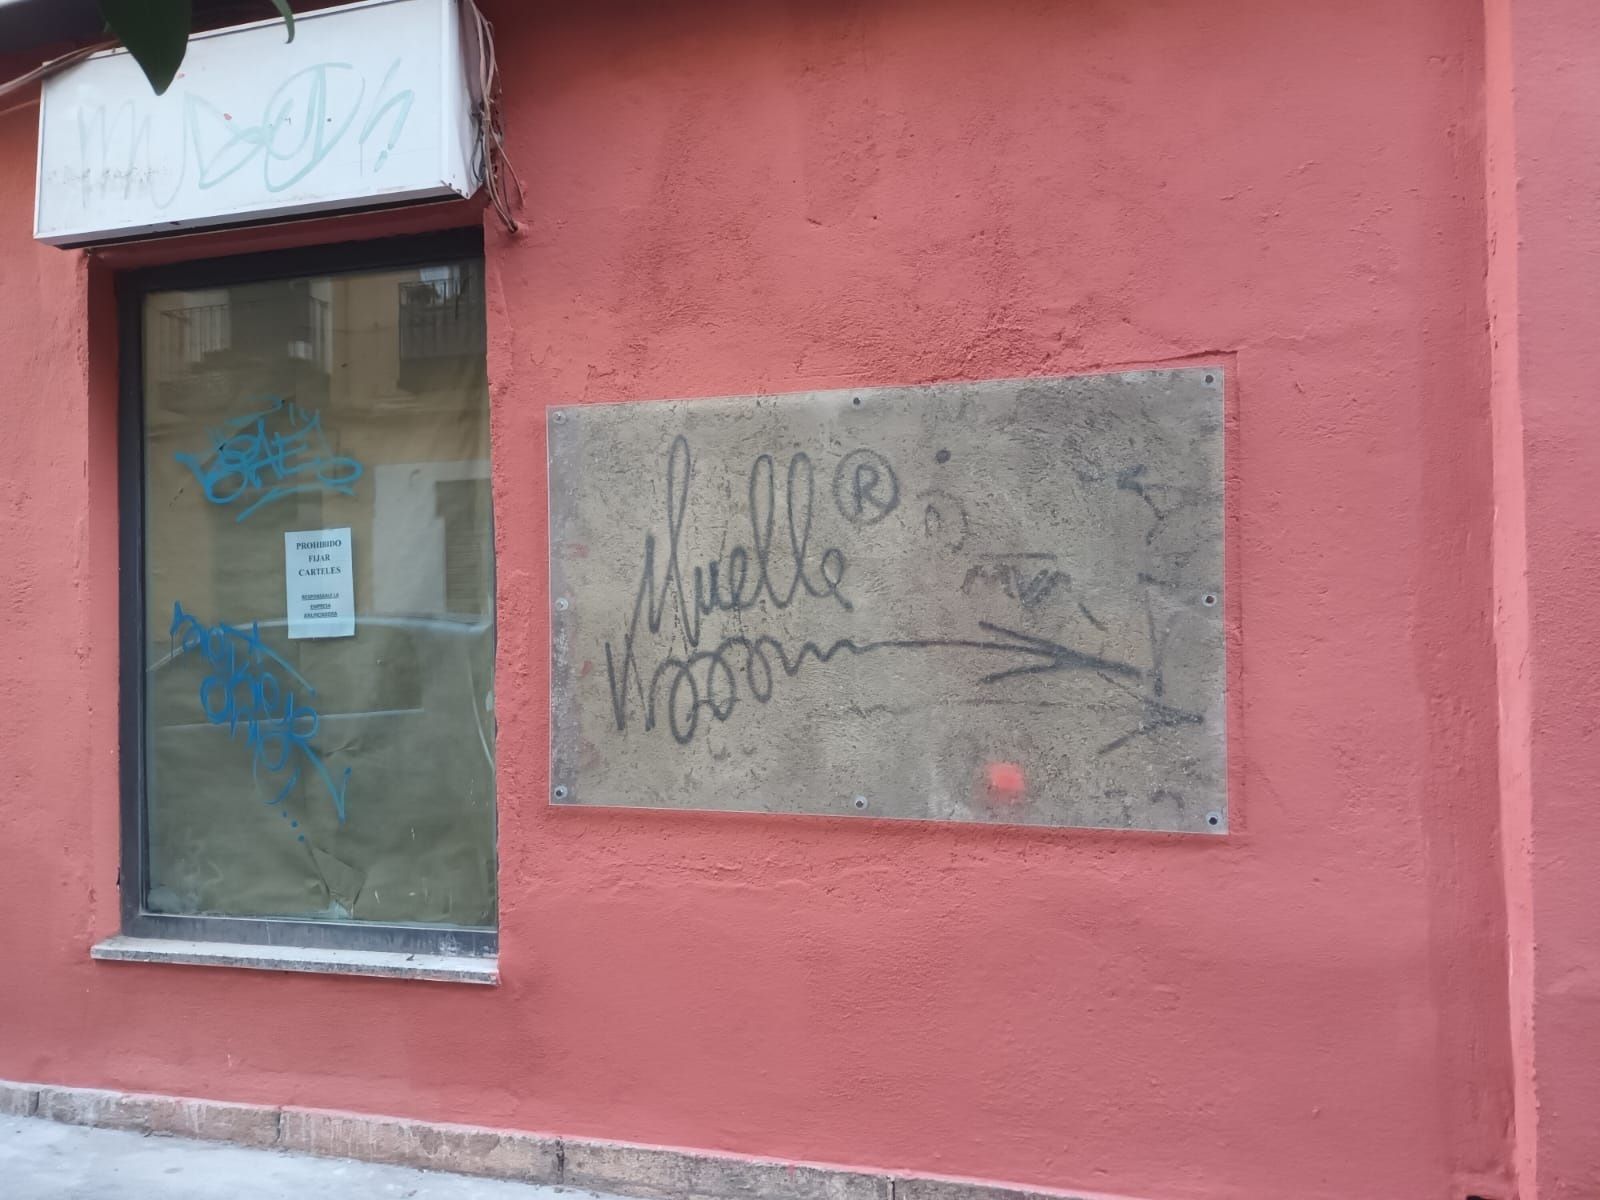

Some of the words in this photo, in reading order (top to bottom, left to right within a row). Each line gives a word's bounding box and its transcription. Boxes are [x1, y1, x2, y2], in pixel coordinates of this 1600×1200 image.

[296, 539, 342, 550] PROHIBIDO
[308, 554, 331, 563] FIJAR
[298, 566, 342, 577] CARTELES
